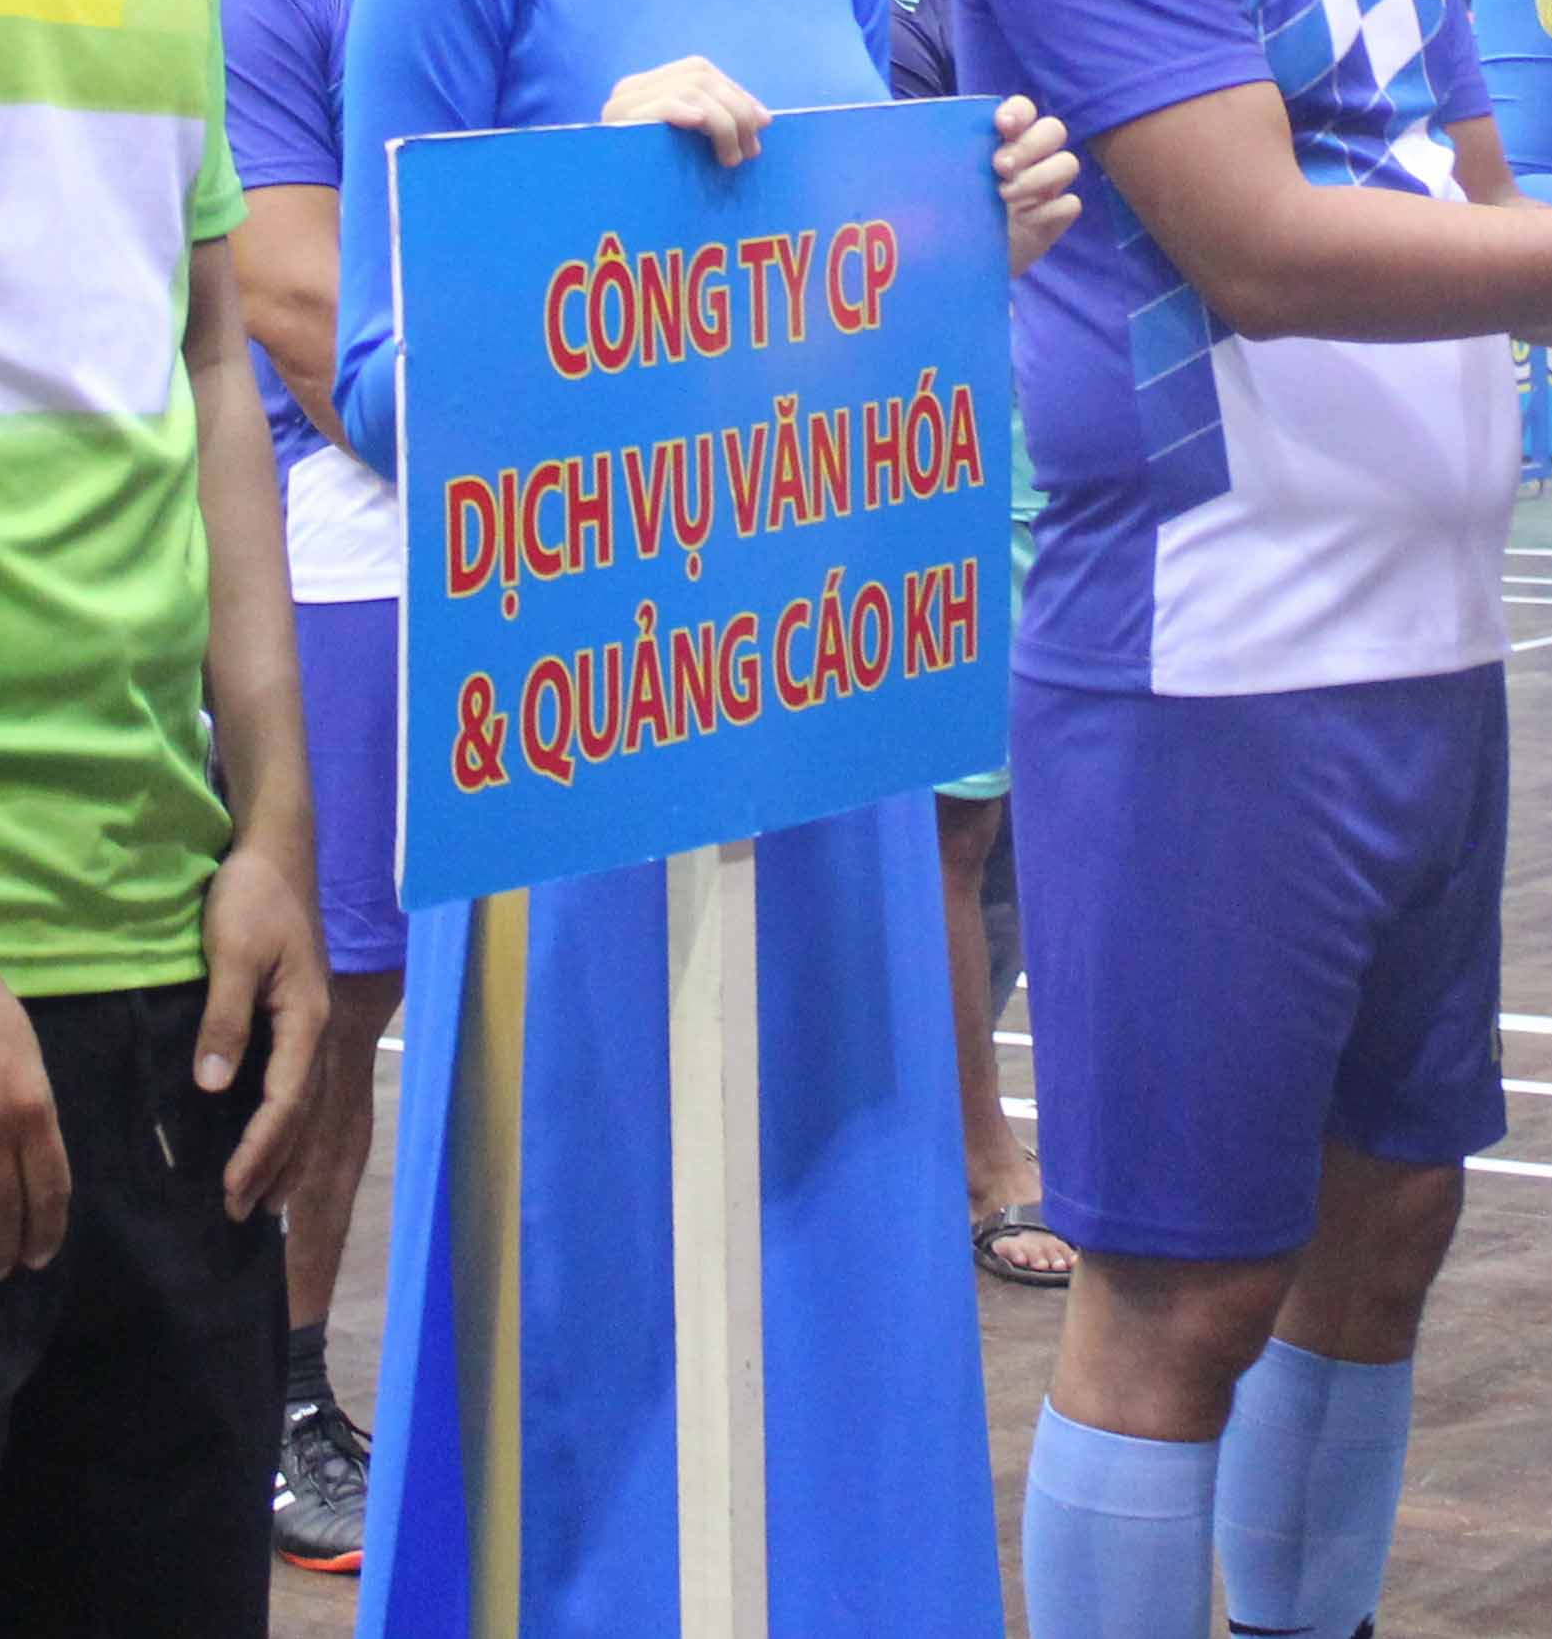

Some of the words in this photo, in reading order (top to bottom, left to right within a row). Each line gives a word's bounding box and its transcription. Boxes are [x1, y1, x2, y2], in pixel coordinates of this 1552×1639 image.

[544, 232, 730, 379] CÔNG
[739, 230, 816, 348] TY
[826, 218, 897, 335] CP
[445, 453, 614, 620] DỊCH
[622, 435, 713, 581] VỤ
[722, 392, 851, 537] VĂN
[862, 367, 985, 510] HÓA
[452, 671, 509, 793] &
[519, 599, 761, 786] QUẢNG
[773, 568, 895, 712] CÁO
[903, 557, 979, 679] KH
